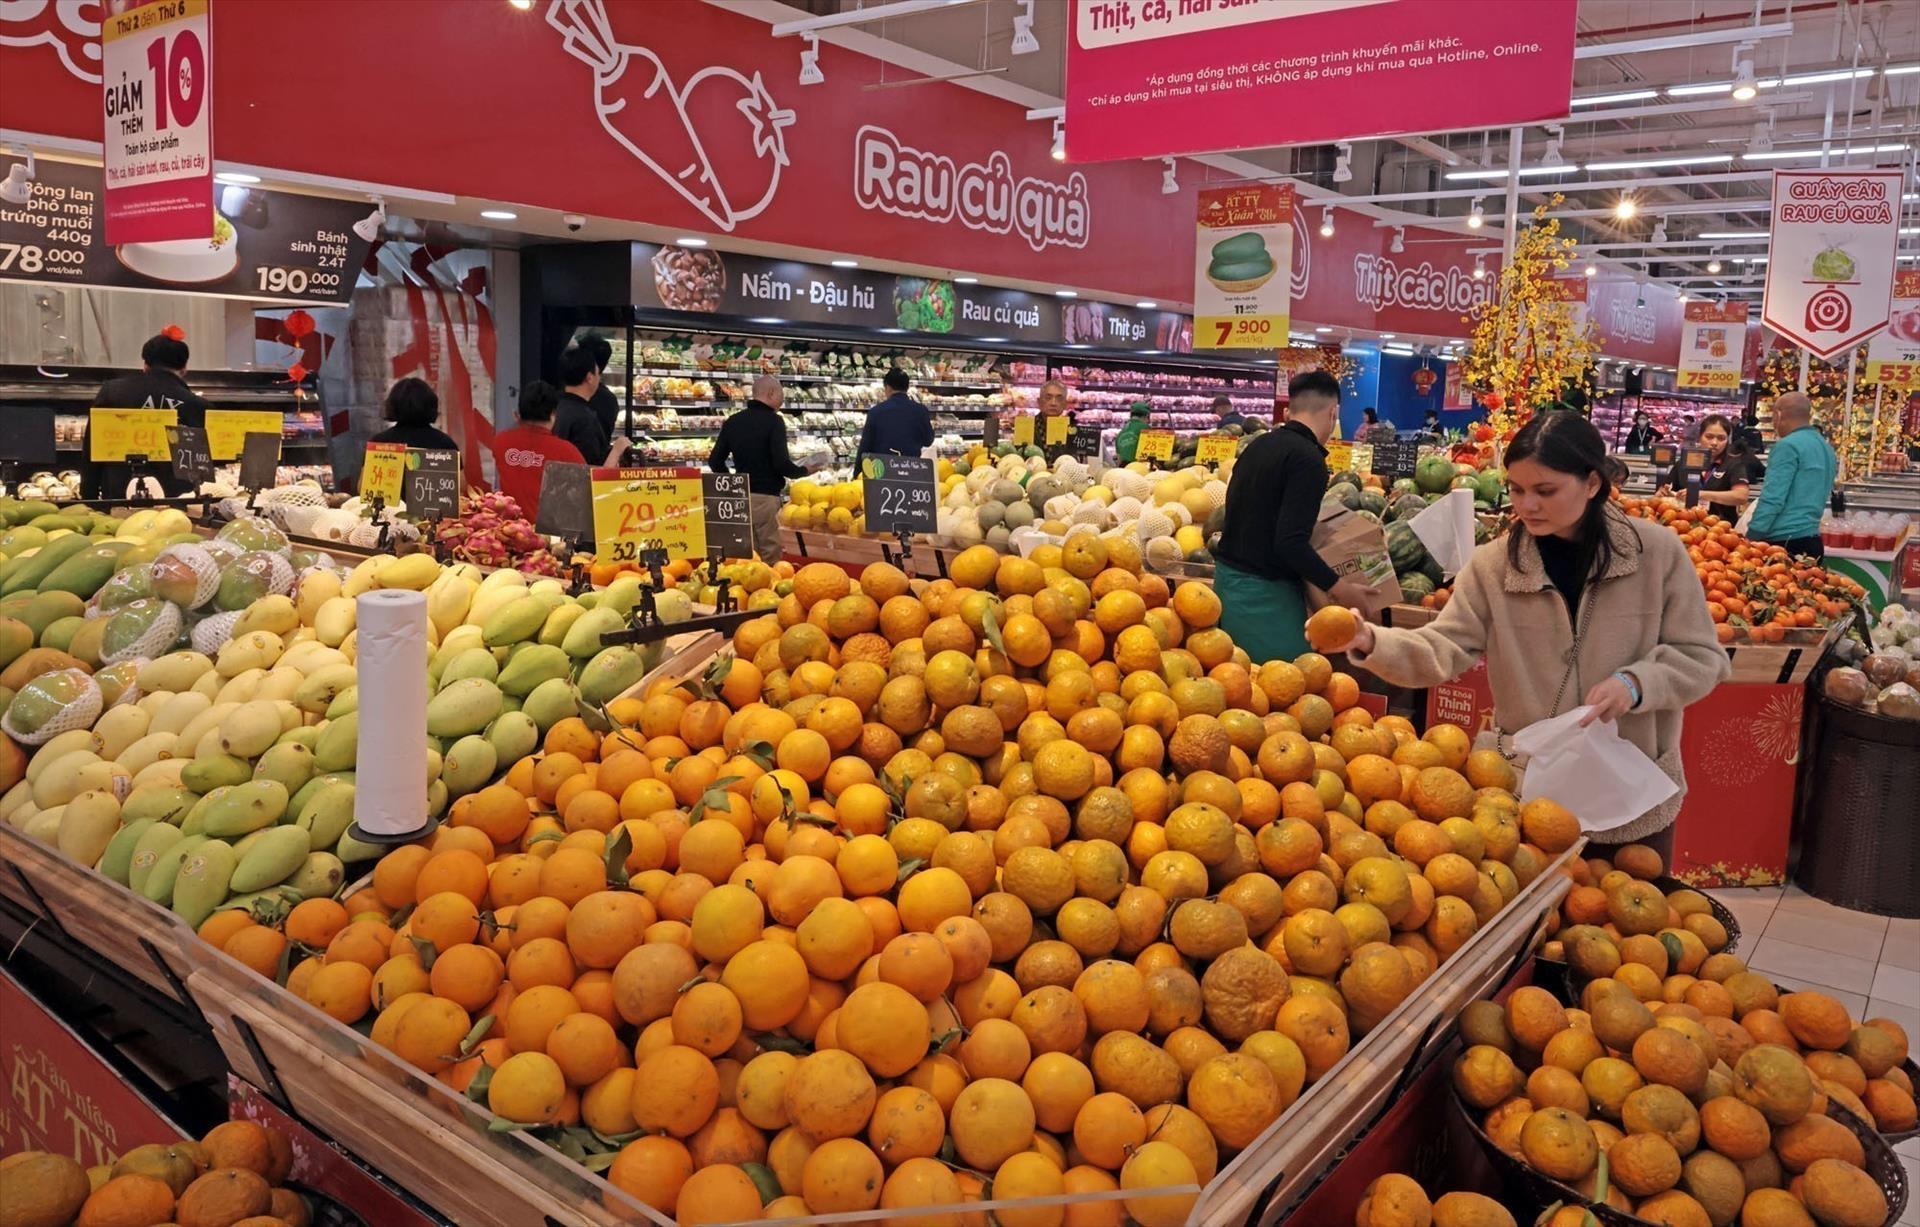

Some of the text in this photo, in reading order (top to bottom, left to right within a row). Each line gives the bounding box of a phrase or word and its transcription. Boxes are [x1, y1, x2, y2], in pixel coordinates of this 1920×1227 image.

[133, 15, 139, 29] 2
[158, 3, 176, 21] Thứ
[178, 0, 185, 15] 6
[1090, 1, 1135, 33] Thịt,
[1167, 72, 1193, 84] dụng
[1251, 60, 1271, 72] các
[1274, 54, 1317, 69] chương
[1321, 51, 1348, 64] trình
[1352, 42, 1397, 60] khuyến
[1401, 40, 1424, 53] mãi
[1428, 36, 1462, 51] khác.
[1109, 92, 1122, 106] áp
[1124, 89, 1149, 104] dụng
[1152, 85, 1167, 98] khi
[1169, 86, 1191, 97] mua
[1195, 83, 1208, 96] tại
[1211, 79, 1233, 91] siêu
[1256, 69, 1300, 86] KHÔNG
[1303, 67, 1318, 82] áp
[1322, 63, 1352, 79] dụng
[1356, 61, 1374, 74] khi
[1377, 59, 1405, 71] mua
[1408, 55, 1433, 69] qua
[1437, 47, 1490, 65] Hotline,
[1493, 42, 1543, 58] Online.
[105, 71, 143, 117] GIẢM
[120, 113, 143, 136] THÊM
[70, 187, 94, 201] lan
[859, 132, 1087, 245] Rau củ quả
[1845, 180, 1884, 199] CÂN
[0, 209, 92, 229] trứng muối
[63, 203, 93, 215] mai
[1782, 202, 1891, 223] RAU CỦ QUẢ
[47, 229, 91, 246] 440g
[317, 230, 348, 244] Bánh
[290, 240, 348, 258] sinh nhật
[318, 256, 346, 268] 2.4T
[742, 271, 791, 301] Nấm
[809, 281, 848, 312] Đậu
[852, 285, 875, 309] hũ
[1356, 257, 1396, 308] Thịt
[1400, 266, 1445, 306] các
[962, 299, 1040, 328] Rau củ quả
[1108, 317, 1146, 341] Thịt gà
[620, 468, 677, 479] KHUYẾN MÃI
